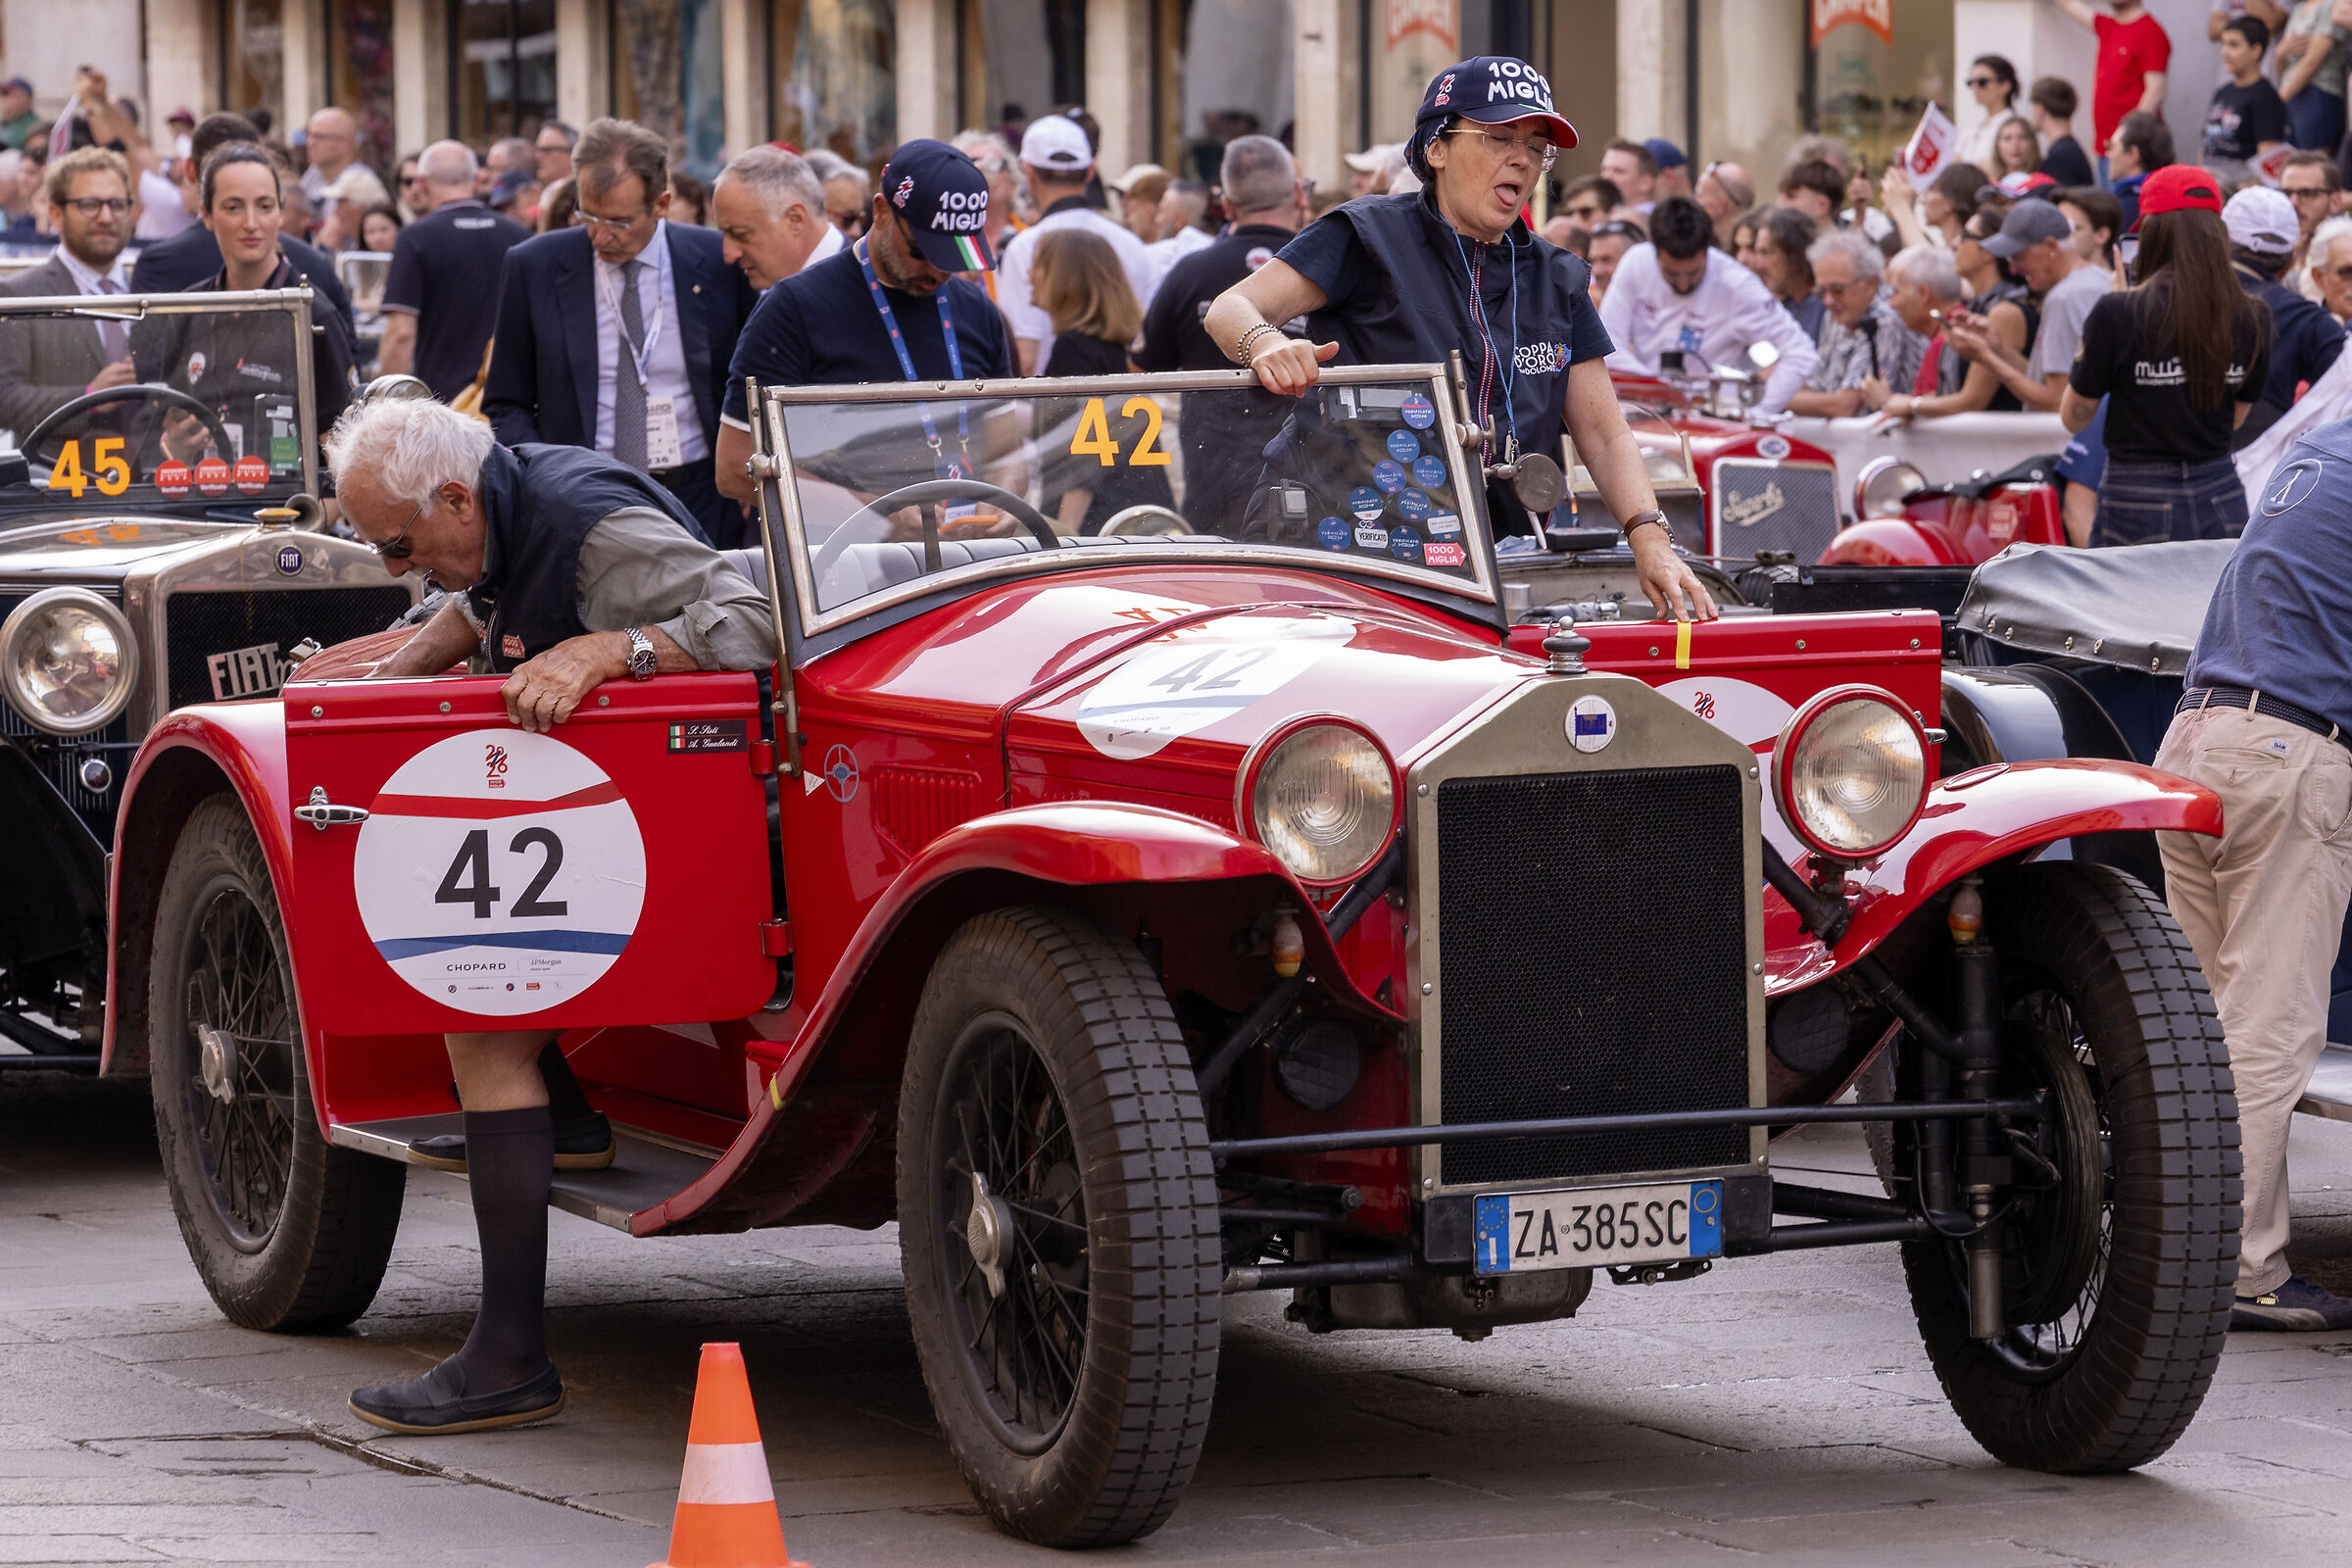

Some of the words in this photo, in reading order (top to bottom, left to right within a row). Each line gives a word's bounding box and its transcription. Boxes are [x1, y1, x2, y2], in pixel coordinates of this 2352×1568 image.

[1489, 62, 1551, 94] 1000
[939, 190, 988, 211] 1000
[1514, 352, 1556, 368] D'ORO
[1515, 341, 1554, 358] COPPA
[1070, 396, 1173, 466] 42
[48, 437, 130, 498] 45
[280, 553, 299, 568] FIAT
[1428, 555, 1459, 564] MIGLIA
[207, 643, 279, 701] FIAT
[1149, 646, 1277, 694] 42
[703, 737, 739, 748] Gualandi
[435, 827, 568, 918] 42
[446, 962, 507, 972] CHOPARD
[1514, 1208, 1558, 1258] ZA
[1572, 1199, 1688, 1252] 385SC
